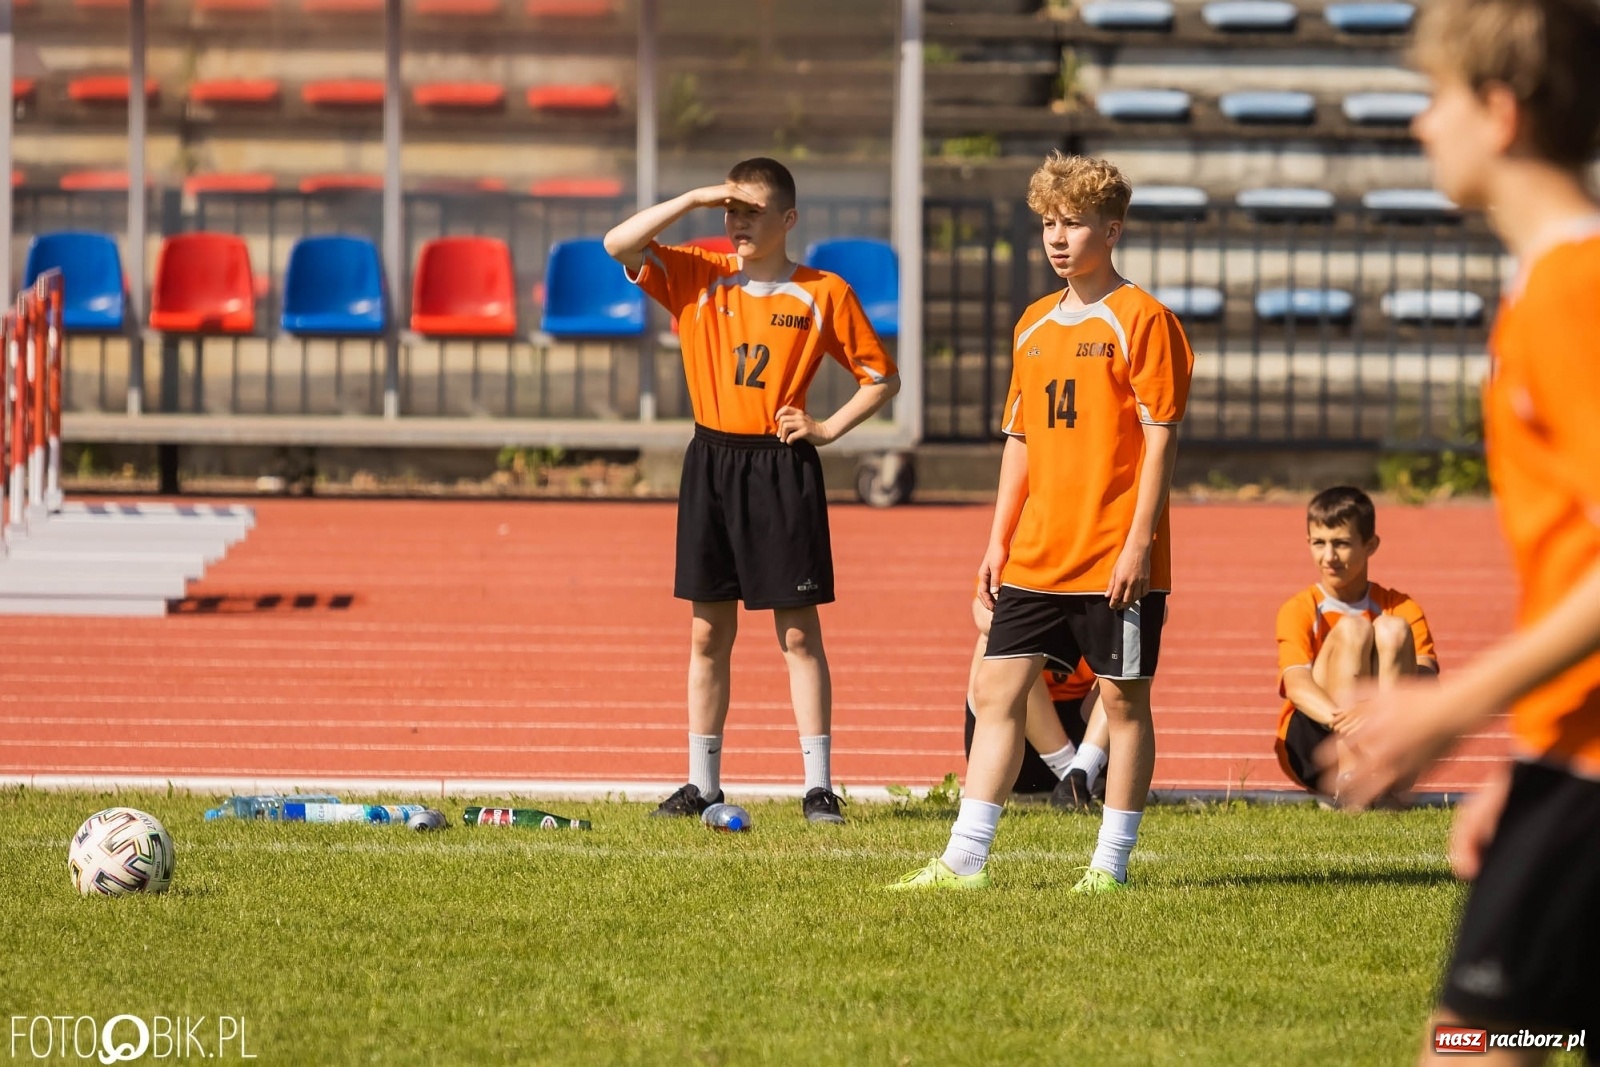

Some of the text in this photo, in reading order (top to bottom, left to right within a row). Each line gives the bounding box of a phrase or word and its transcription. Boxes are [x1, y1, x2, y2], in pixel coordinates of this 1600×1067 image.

[770, 313, 811, 331] ZSOMS
[733, 342, 770, 390] 12
[1075, 342, 1115, 358] ZSOMS
[1045, 378, 1077, 429] 14
